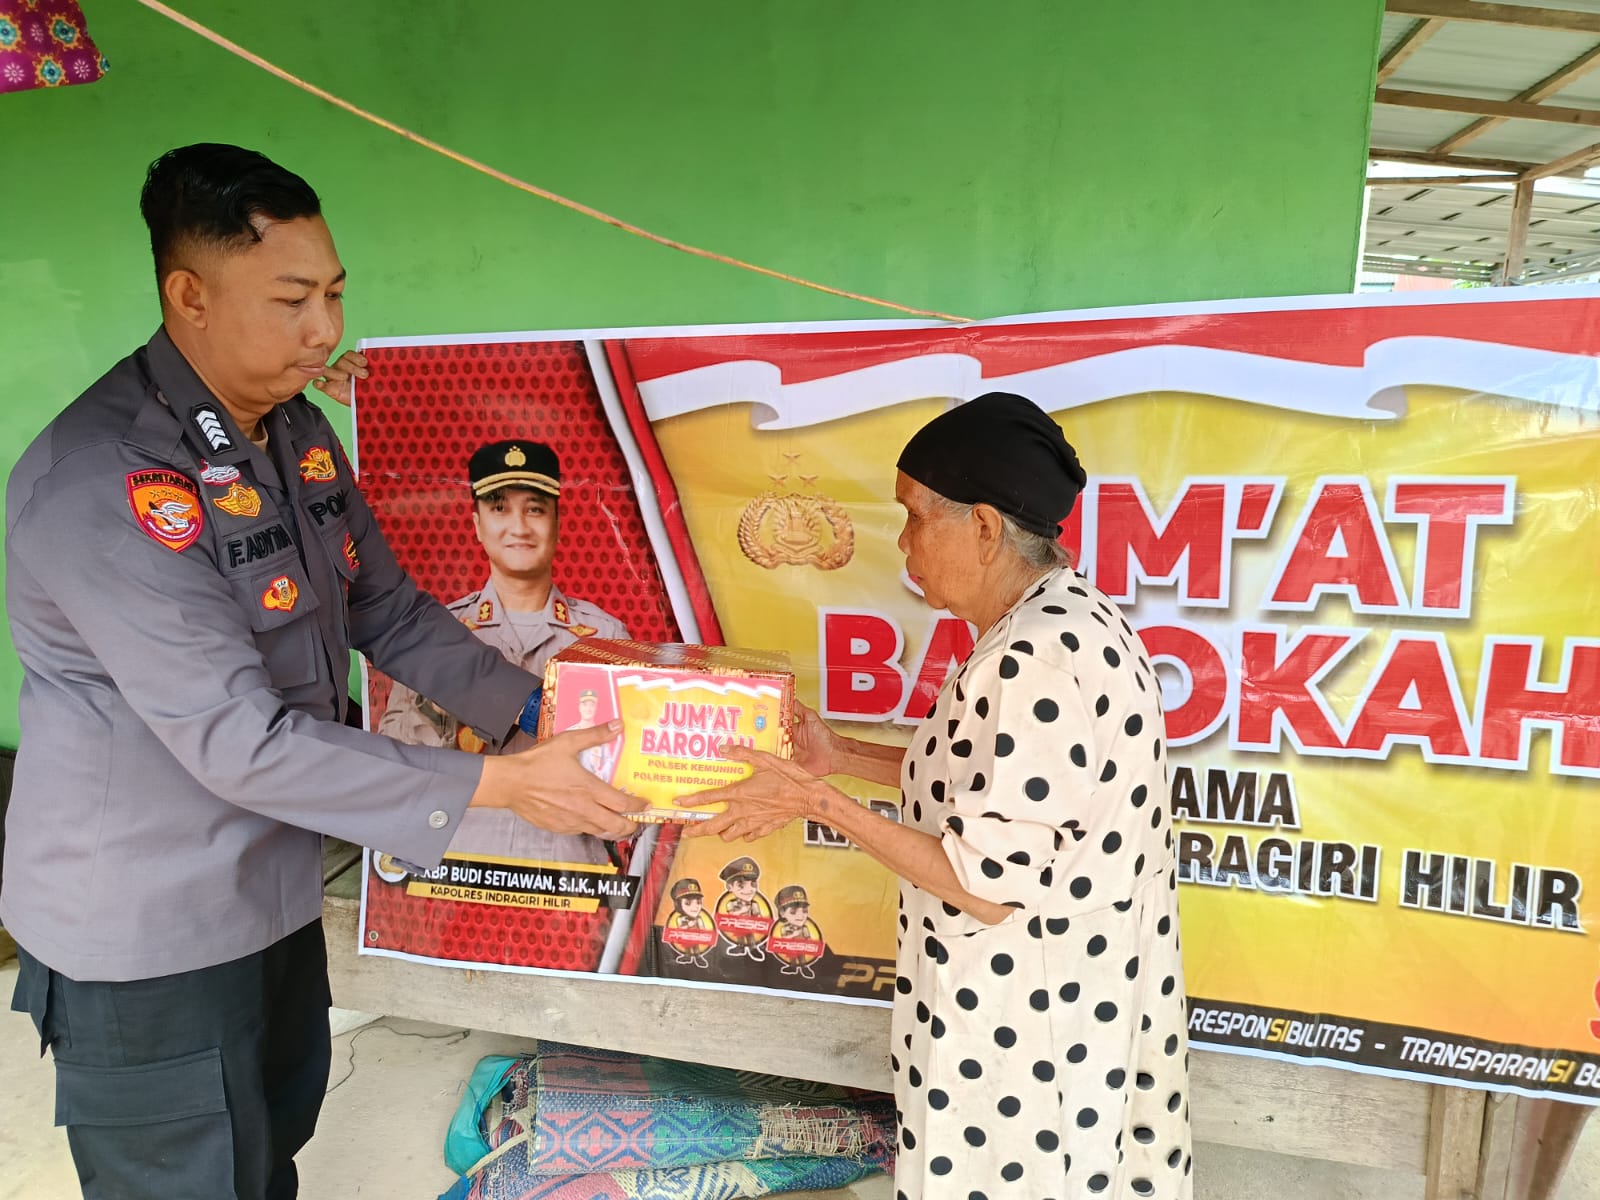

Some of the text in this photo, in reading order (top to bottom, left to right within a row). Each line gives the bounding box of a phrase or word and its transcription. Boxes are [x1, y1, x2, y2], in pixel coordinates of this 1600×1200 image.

[818, 607, 1600, 778] BAOKAH
[659, 701, 742, 732] JUM'AT
[633, 771, 673, 783] POLRES
[648, 759, 745, 775] POLSEK KEMUNING
[451, 866, 482, 884] BUDI
[484, 870, 556, 893] SETIAWAN,
[597, 879, 631, 897] M.I.K
[1401, 848, 1587, 933] HILIR
[430, 885, 571, 908] KAPOLRES INDRAGIRI HILIR
[720, 917, 769, 931] PRESISI
[669, 930, 712, 942] PRESISI
[773, 941, 818, 952] PRESISI
[1188, 1007, 1364, 1052] RESPONSIBILITAS
[1400, 1035, 1576, 1083] TRANSPARANSI
